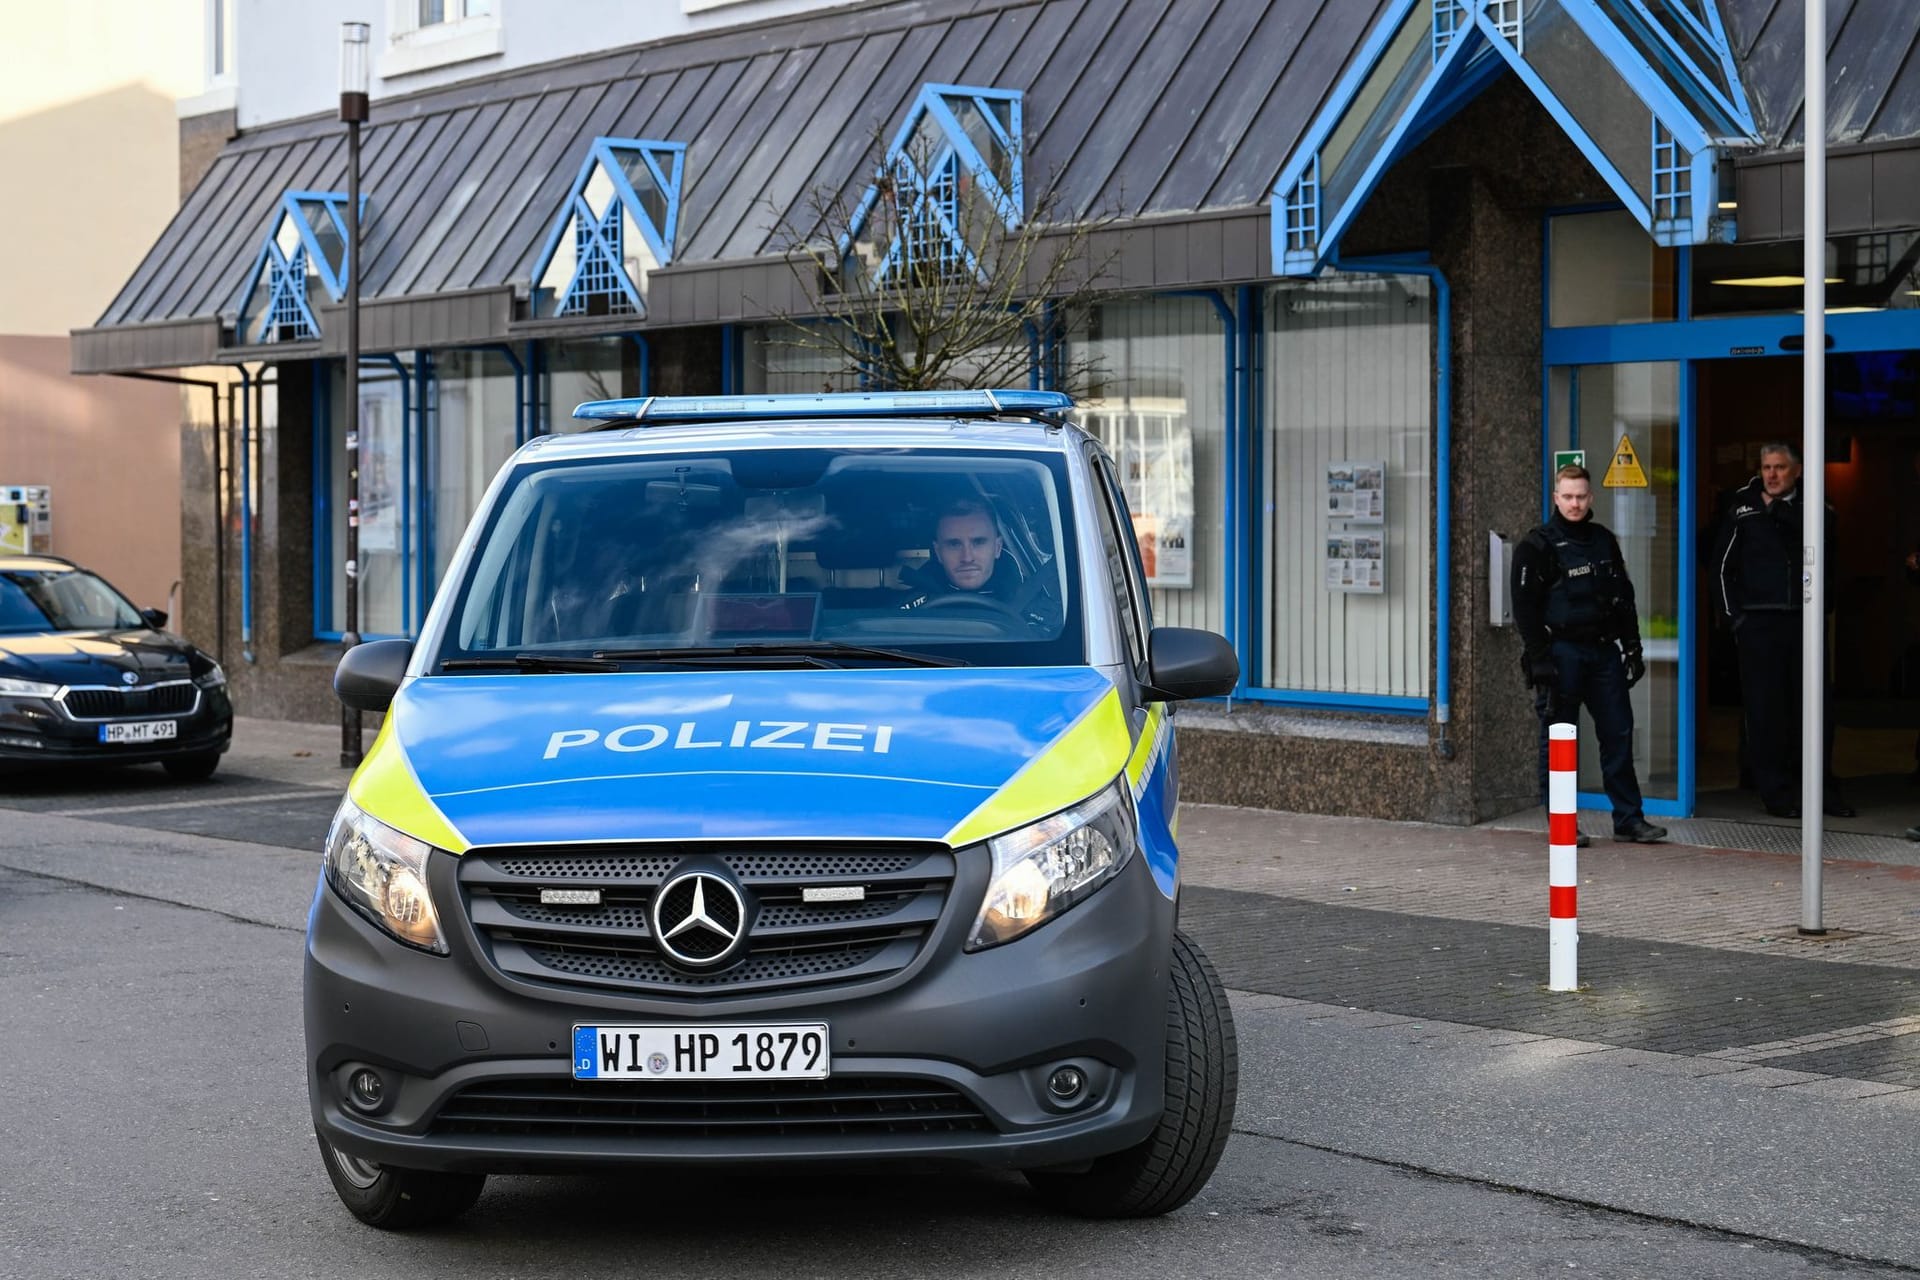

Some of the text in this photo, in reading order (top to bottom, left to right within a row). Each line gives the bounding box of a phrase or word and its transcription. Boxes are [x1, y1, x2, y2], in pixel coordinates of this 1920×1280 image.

[107, 723, 174, 739] HP MT 491
[543, 720, 893, 760] POLIZEI
[582, 1058, 591, 1070] D
[600, 1032, 822, 1072] WI HP 1879
